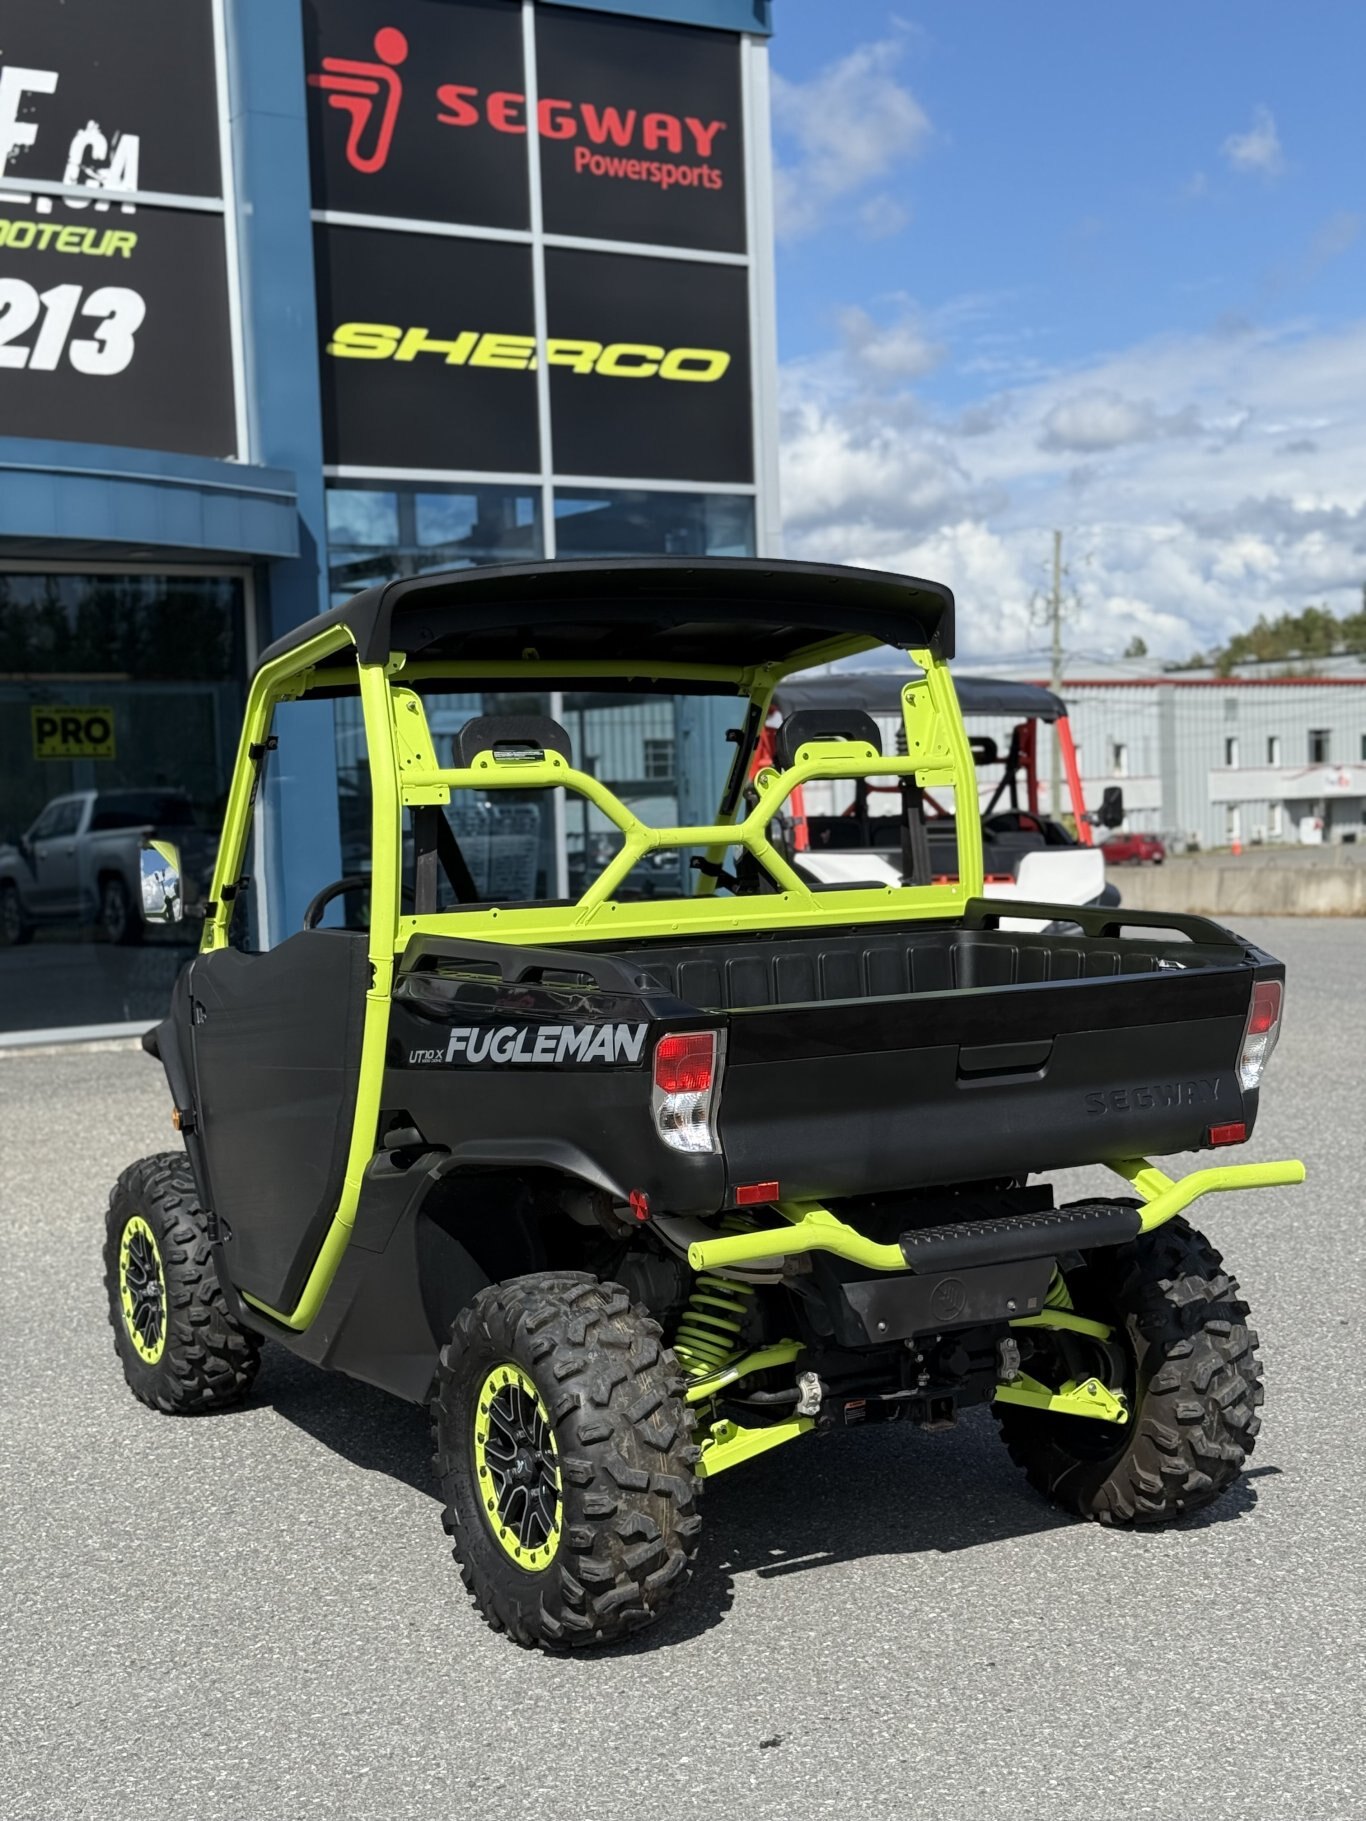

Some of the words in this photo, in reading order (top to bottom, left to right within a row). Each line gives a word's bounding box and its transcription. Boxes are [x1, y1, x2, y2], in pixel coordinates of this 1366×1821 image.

[436, 84, 722, 157] SEGWAY
[574, 146, 722, 190] Powersports
[0, 277, 147, 376] 213
[327, 322, 731, 382] SHERCO
[36, 716, 111, 745] PRO
[445, 1023, 648, 1063] FUGLEMAN
[1085, 1078, 1220, 1115] SEGWAY
